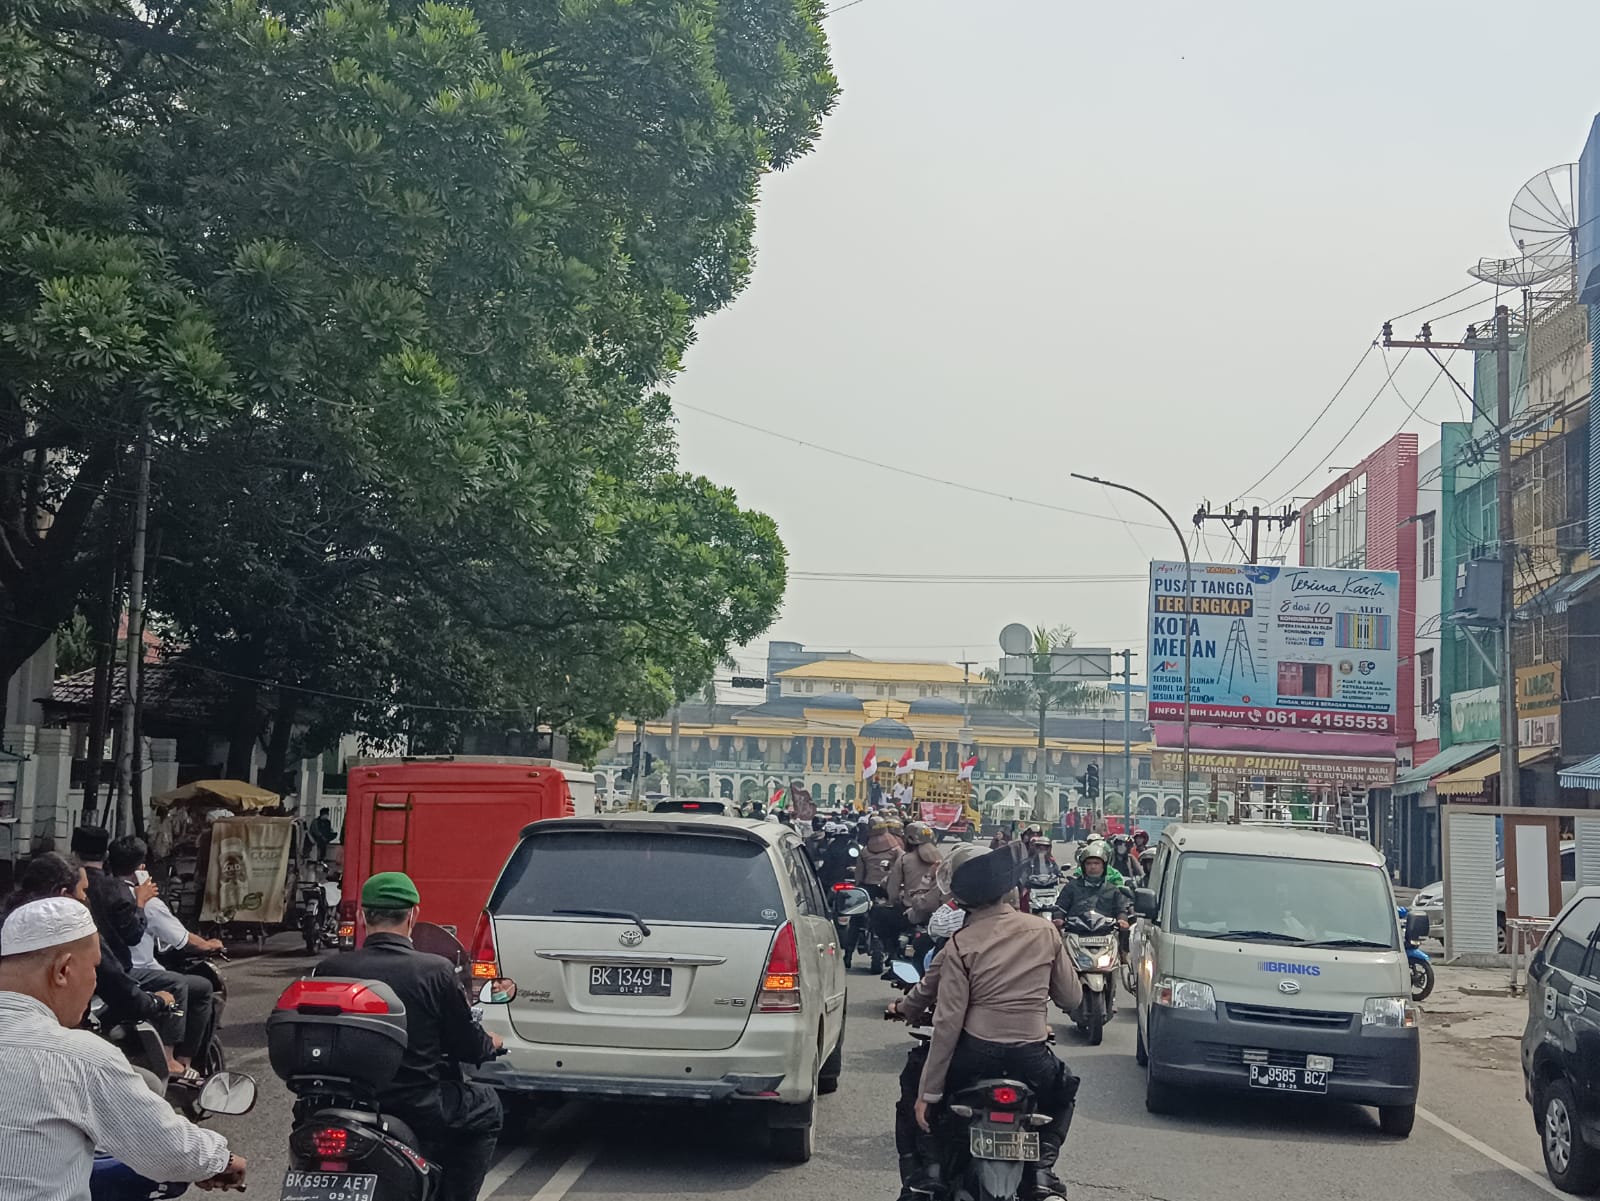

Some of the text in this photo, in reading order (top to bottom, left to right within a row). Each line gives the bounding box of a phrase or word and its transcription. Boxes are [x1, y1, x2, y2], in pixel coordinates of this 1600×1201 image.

[1201, 581, 1253, 595] TANGGA
[1313, 602, 1331, 615] 10
[1154, 617, 1200, 636] KOTA
[1179, 708, 1206, 716] LBIH
[1209, 710, 1246, 718] LANJUT
[1265, 710, 1297, 724] 061
[1311, 713, 1389, 729] 4155553
[1200, 766, 1234, 774] TANGGA
[1236, 768, 1267, 776] SESUAI
[1270, 769, 1300, 777] FUNGSI
[1312, 772, 1364, 780] KEBUTUHAN
[1366, 774, 1390, 782] ANDA
[1300, 764, 1341, 772] TERSEDIA
[1266, 961, 1321, 976] BRINKS
[592, 967, 671, 987] BK 1349 L
[1251, 1066, 1326, 1086] B 9585 BCZ
[343, 1177, 372, 1191] AEY
